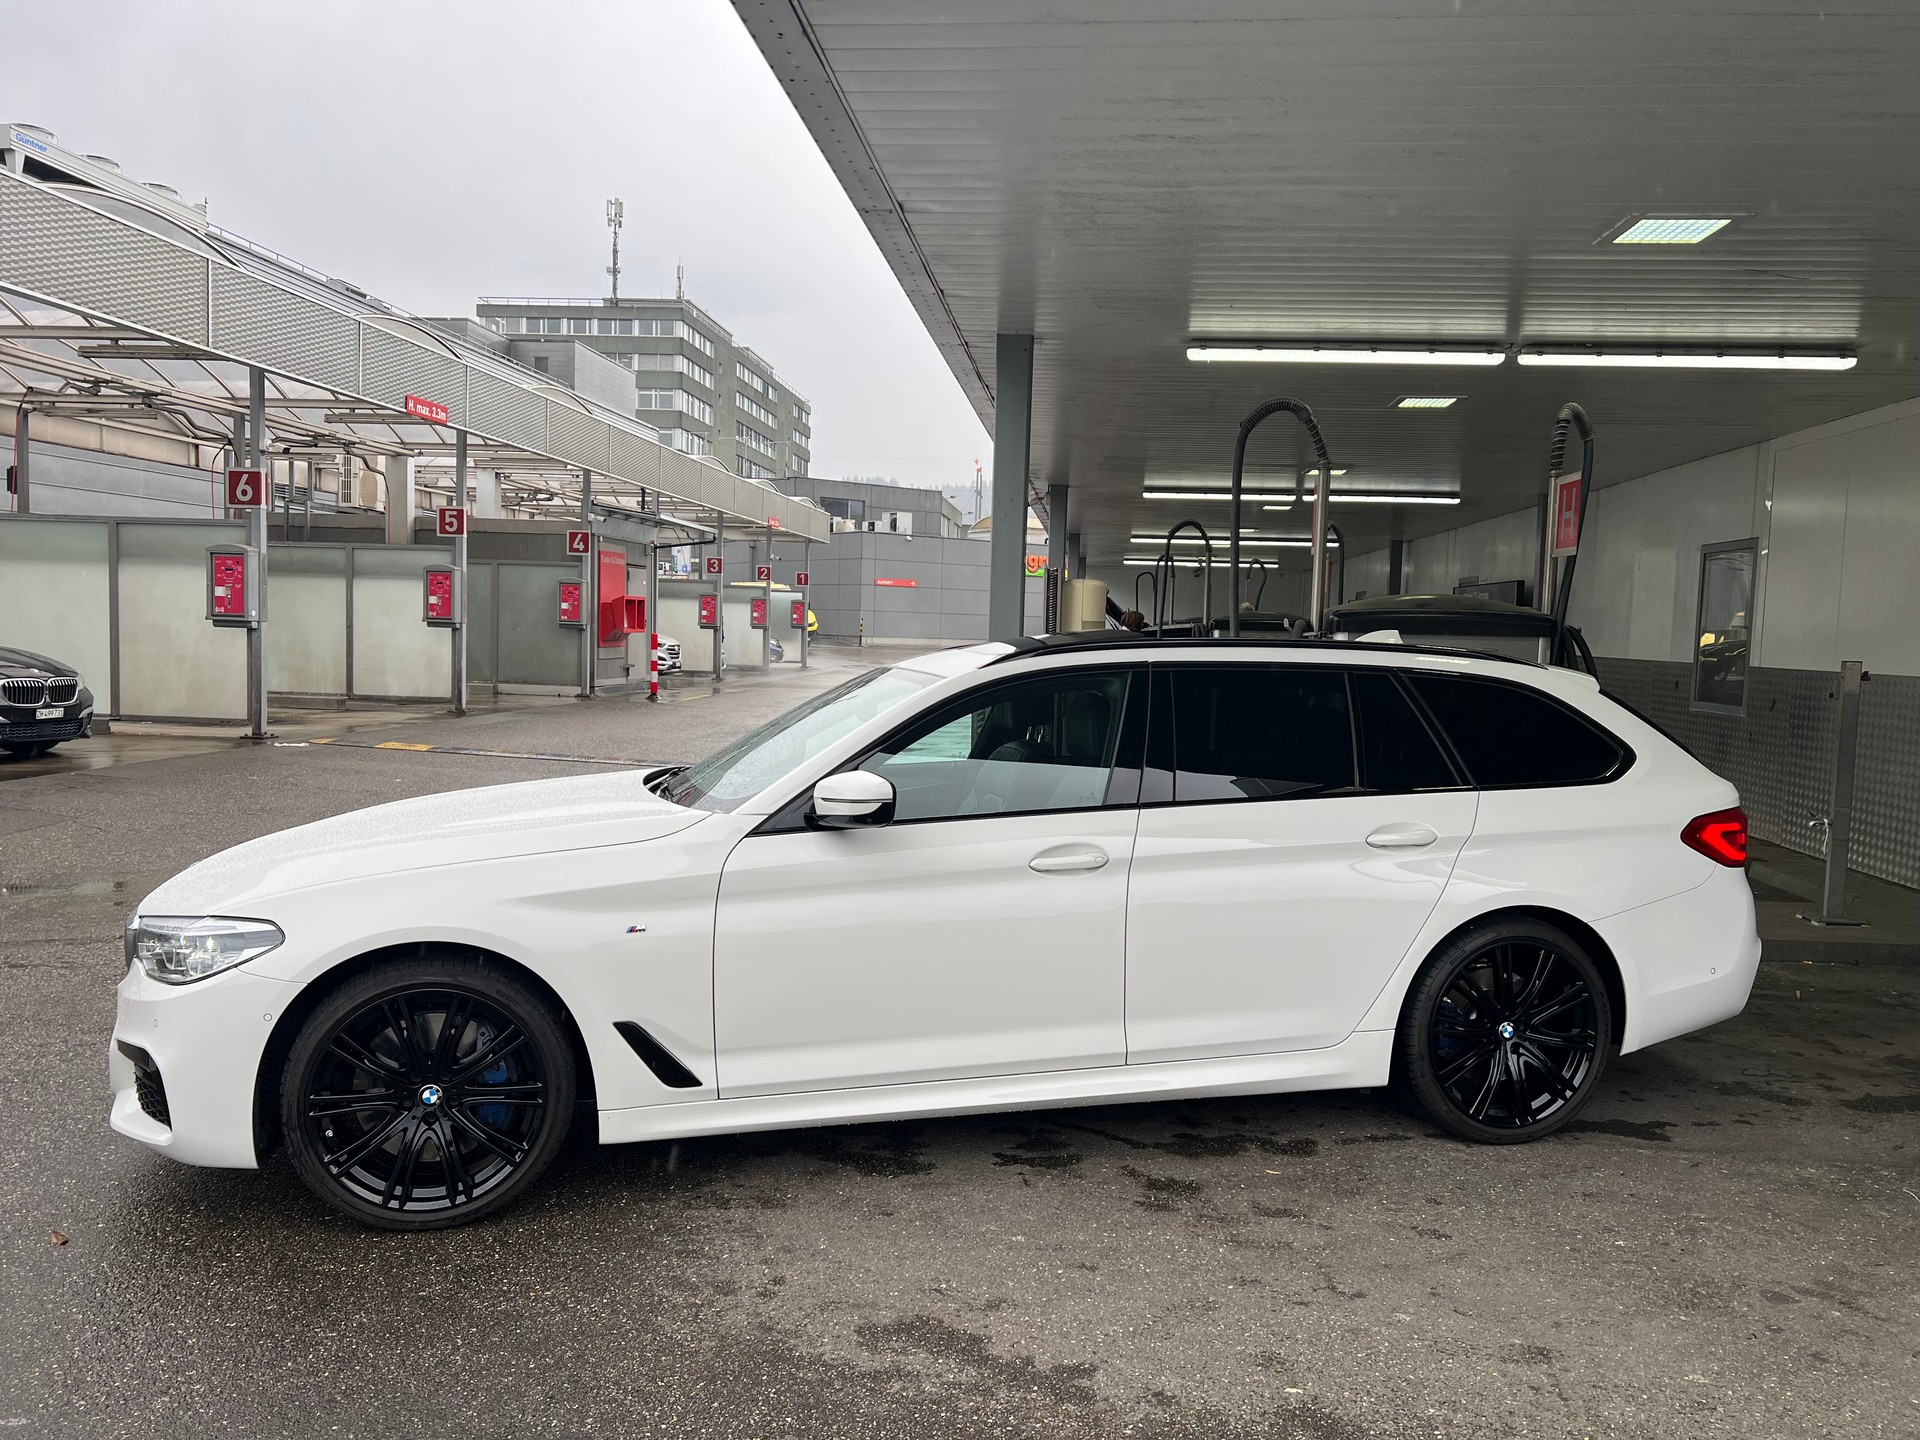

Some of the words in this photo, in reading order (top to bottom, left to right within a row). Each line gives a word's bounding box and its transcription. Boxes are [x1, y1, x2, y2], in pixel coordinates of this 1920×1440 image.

[15, 132, 48, 153] Güntner
[416, 403, 431, 417] max.
[431, 406, 447, 421] 3.3m
[235, 473, 253, 502] 6
[444, 510, 458, 532] 5
[1560, 487, 1577, 541] H
[572, 533, 585, 551] 4
[709, 558, 719, 573] 3
[760, 567, 768, 580] 2
[799, 574, 805, 585] 1
